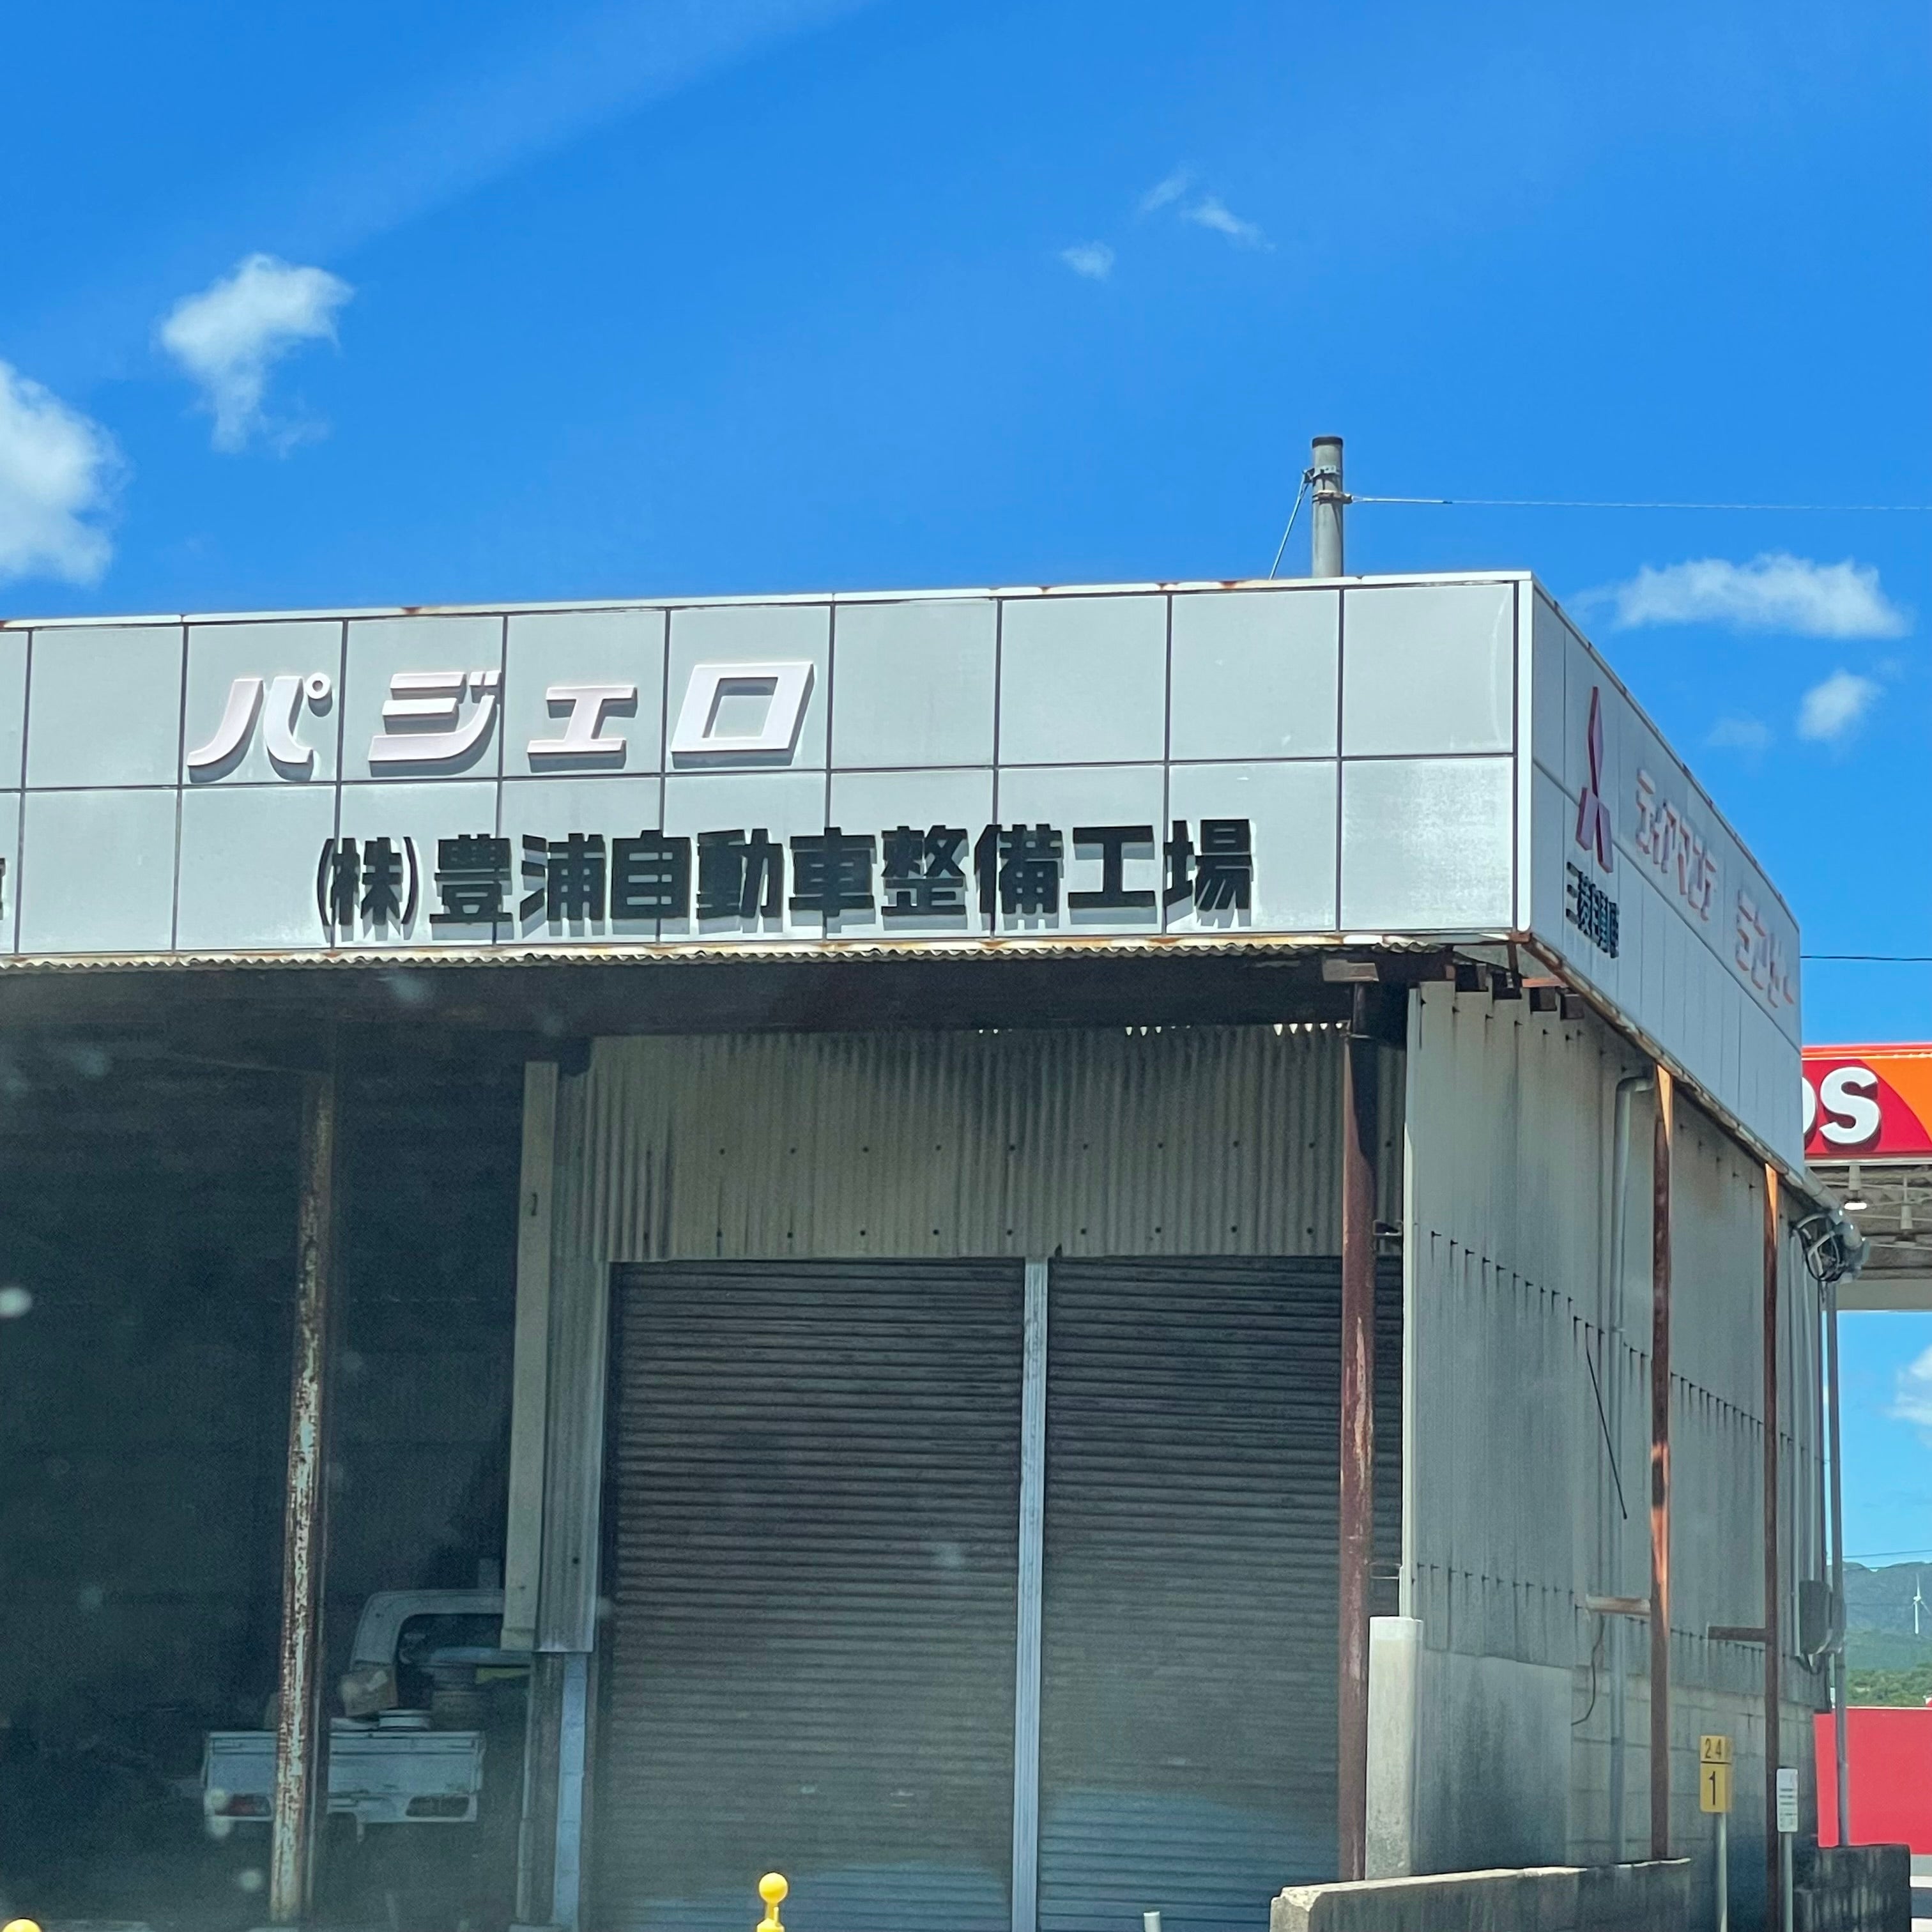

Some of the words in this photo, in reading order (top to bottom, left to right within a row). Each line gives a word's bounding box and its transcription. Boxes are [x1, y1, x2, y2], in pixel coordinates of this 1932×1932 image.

[187, 660, 815, 768] パジェロ
[1705, 1738, 1722, 1759] 24
[1708, 1771, 1716, 1805] 1
